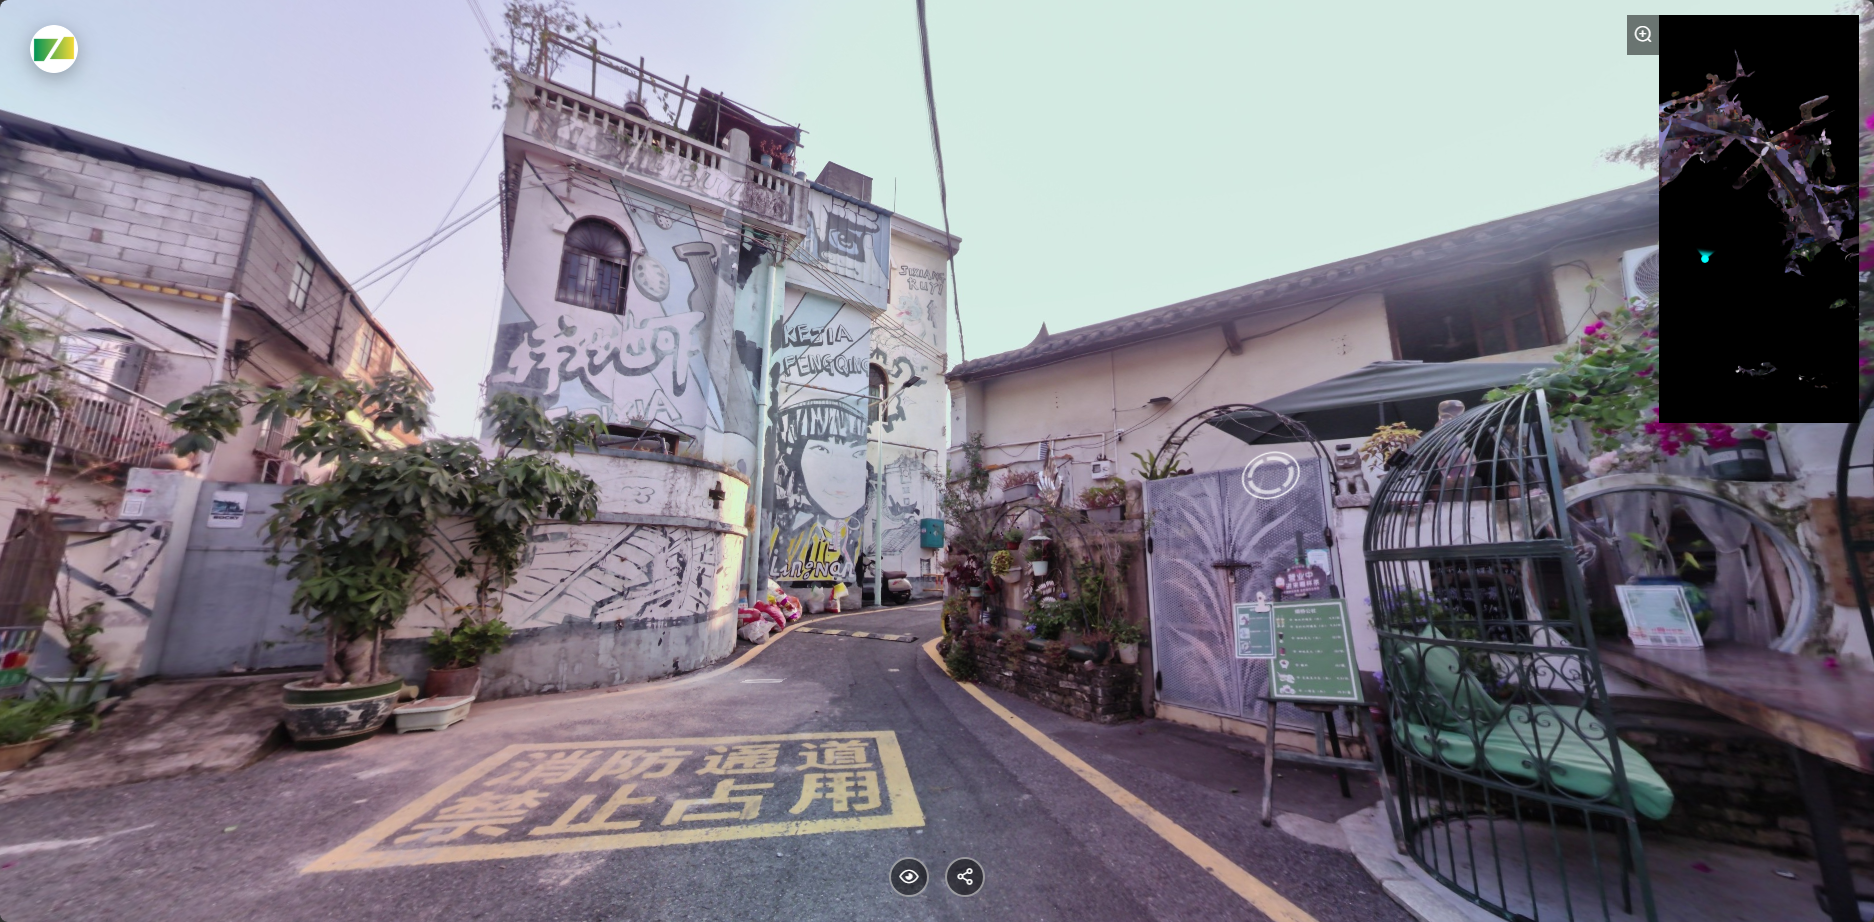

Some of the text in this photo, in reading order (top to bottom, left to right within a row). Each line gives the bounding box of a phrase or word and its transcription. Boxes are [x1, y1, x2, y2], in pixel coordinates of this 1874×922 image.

[898, 265, 946, 285] JIXIANG
[907, 276, 944, 296] RUYI
[781, 322, 854, 348] KEJIA
[1287, 571, 1314, 582] 营业中
[484, 740, 872, 787] 消防通道
[392, 771, 881, 845] 禁止占用
